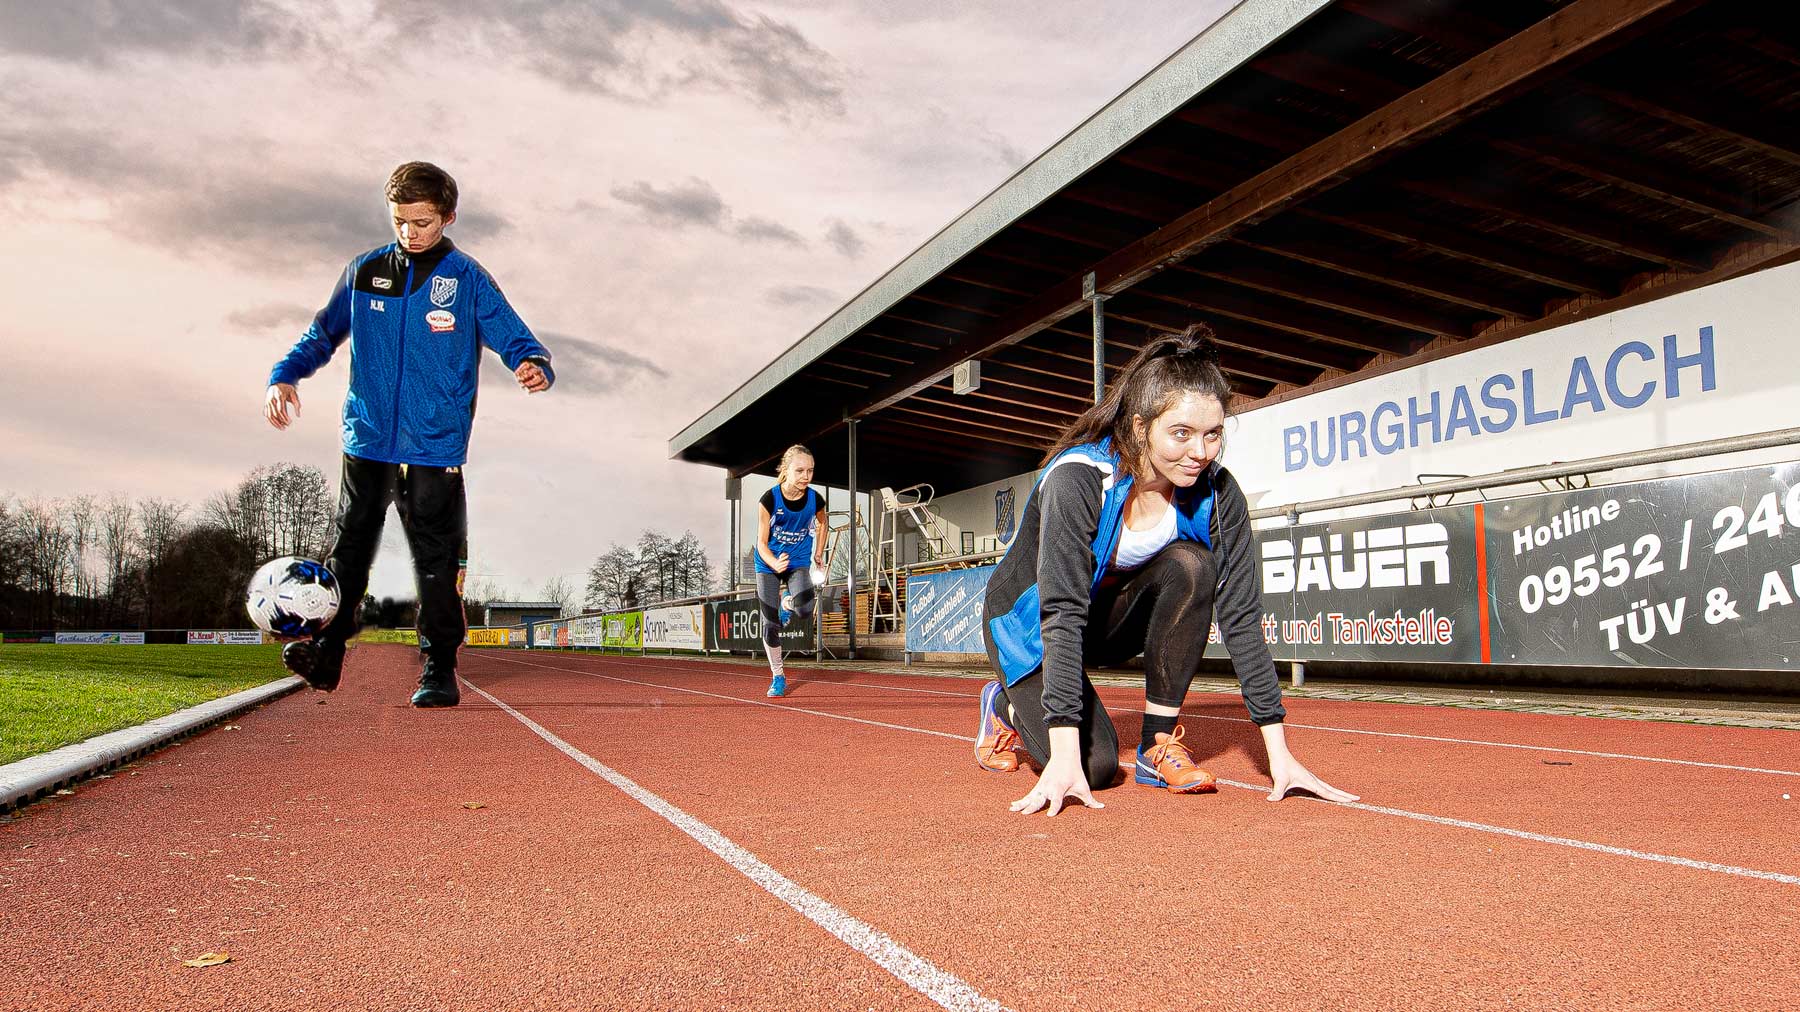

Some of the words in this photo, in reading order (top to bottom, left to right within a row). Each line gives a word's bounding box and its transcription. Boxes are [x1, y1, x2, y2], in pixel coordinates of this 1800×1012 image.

[1284, 326, 1716, 473] BURGHASLACH
[1513, 499, 1621, 556] Hotline
[1262, 522, 1450, 594] BAUER
[1518, 533, 1665, 614] 09552
[1679, 518, 1693, 571] /
[720, 609, 763, 640] N-ERGI
[911, 584, 935, 619] Fußball
[921, 585, 967, 637] Leichtathletik
[1282, 611, 1323, 645] und
[1327, 608, 1453, 646] Tankstelle
[1599, 597, 1687, 651] TÜV
[1704, 586, 1741, 625] &
[1757, 564, 1800, 612] A
[943, 615, 969, 645] Turnen
